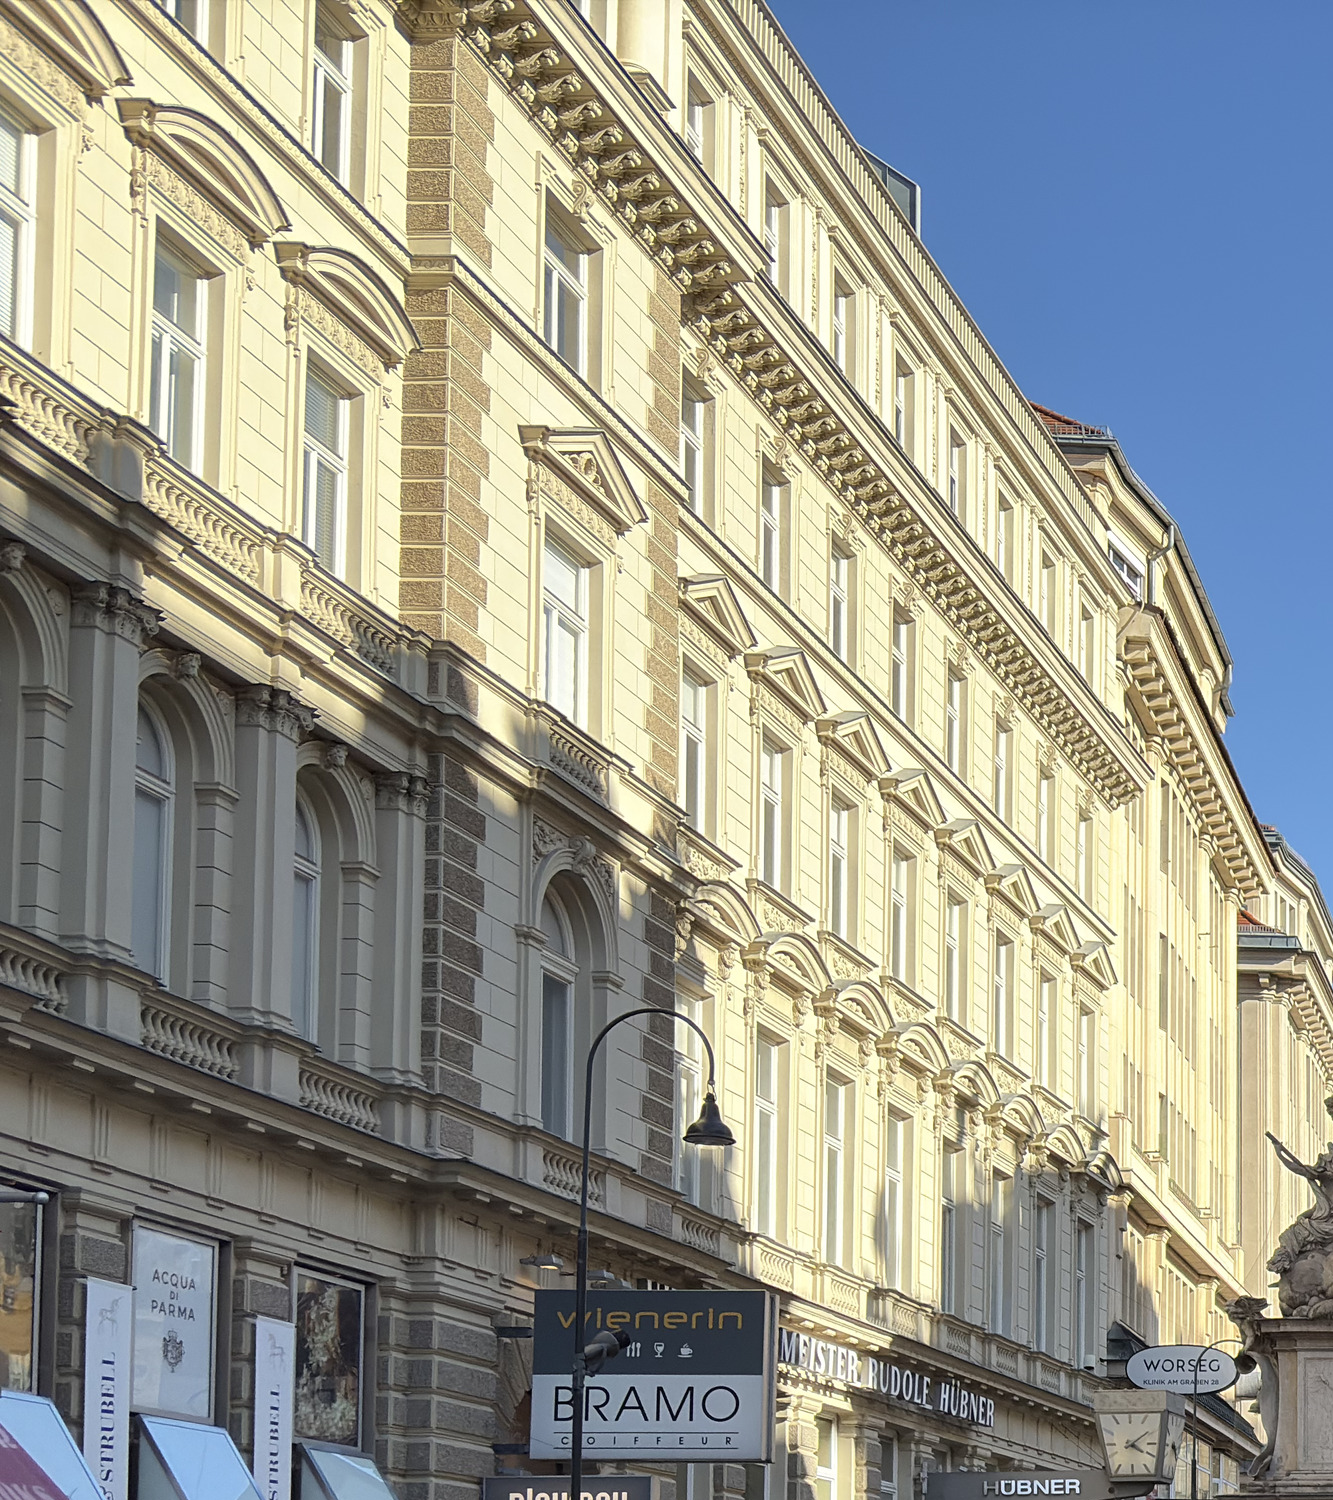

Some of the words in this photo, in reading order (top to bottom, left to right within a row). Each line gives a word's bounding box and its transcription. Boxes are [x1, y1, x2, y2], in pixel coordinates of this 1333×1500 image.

[152, 1269, 197, 1291] ACQUA
[170, 1290, 179, 1301] DI
[151, 1300, 196, 1322] PARMA
[1143, 1359, 1221, 1373] WORSEG
[779, 1328, 862, 1388] MEISTER
[938, 1377, 996, 1428] HÜBNER
[553, 1386, 740, 1423] BRAMO
[100, 1352, 116, 1483] STRUBELL
[560, 1436, 732, 1446] COIFFEUR
[983, 1479, 1081, 1496] HÜBNER
